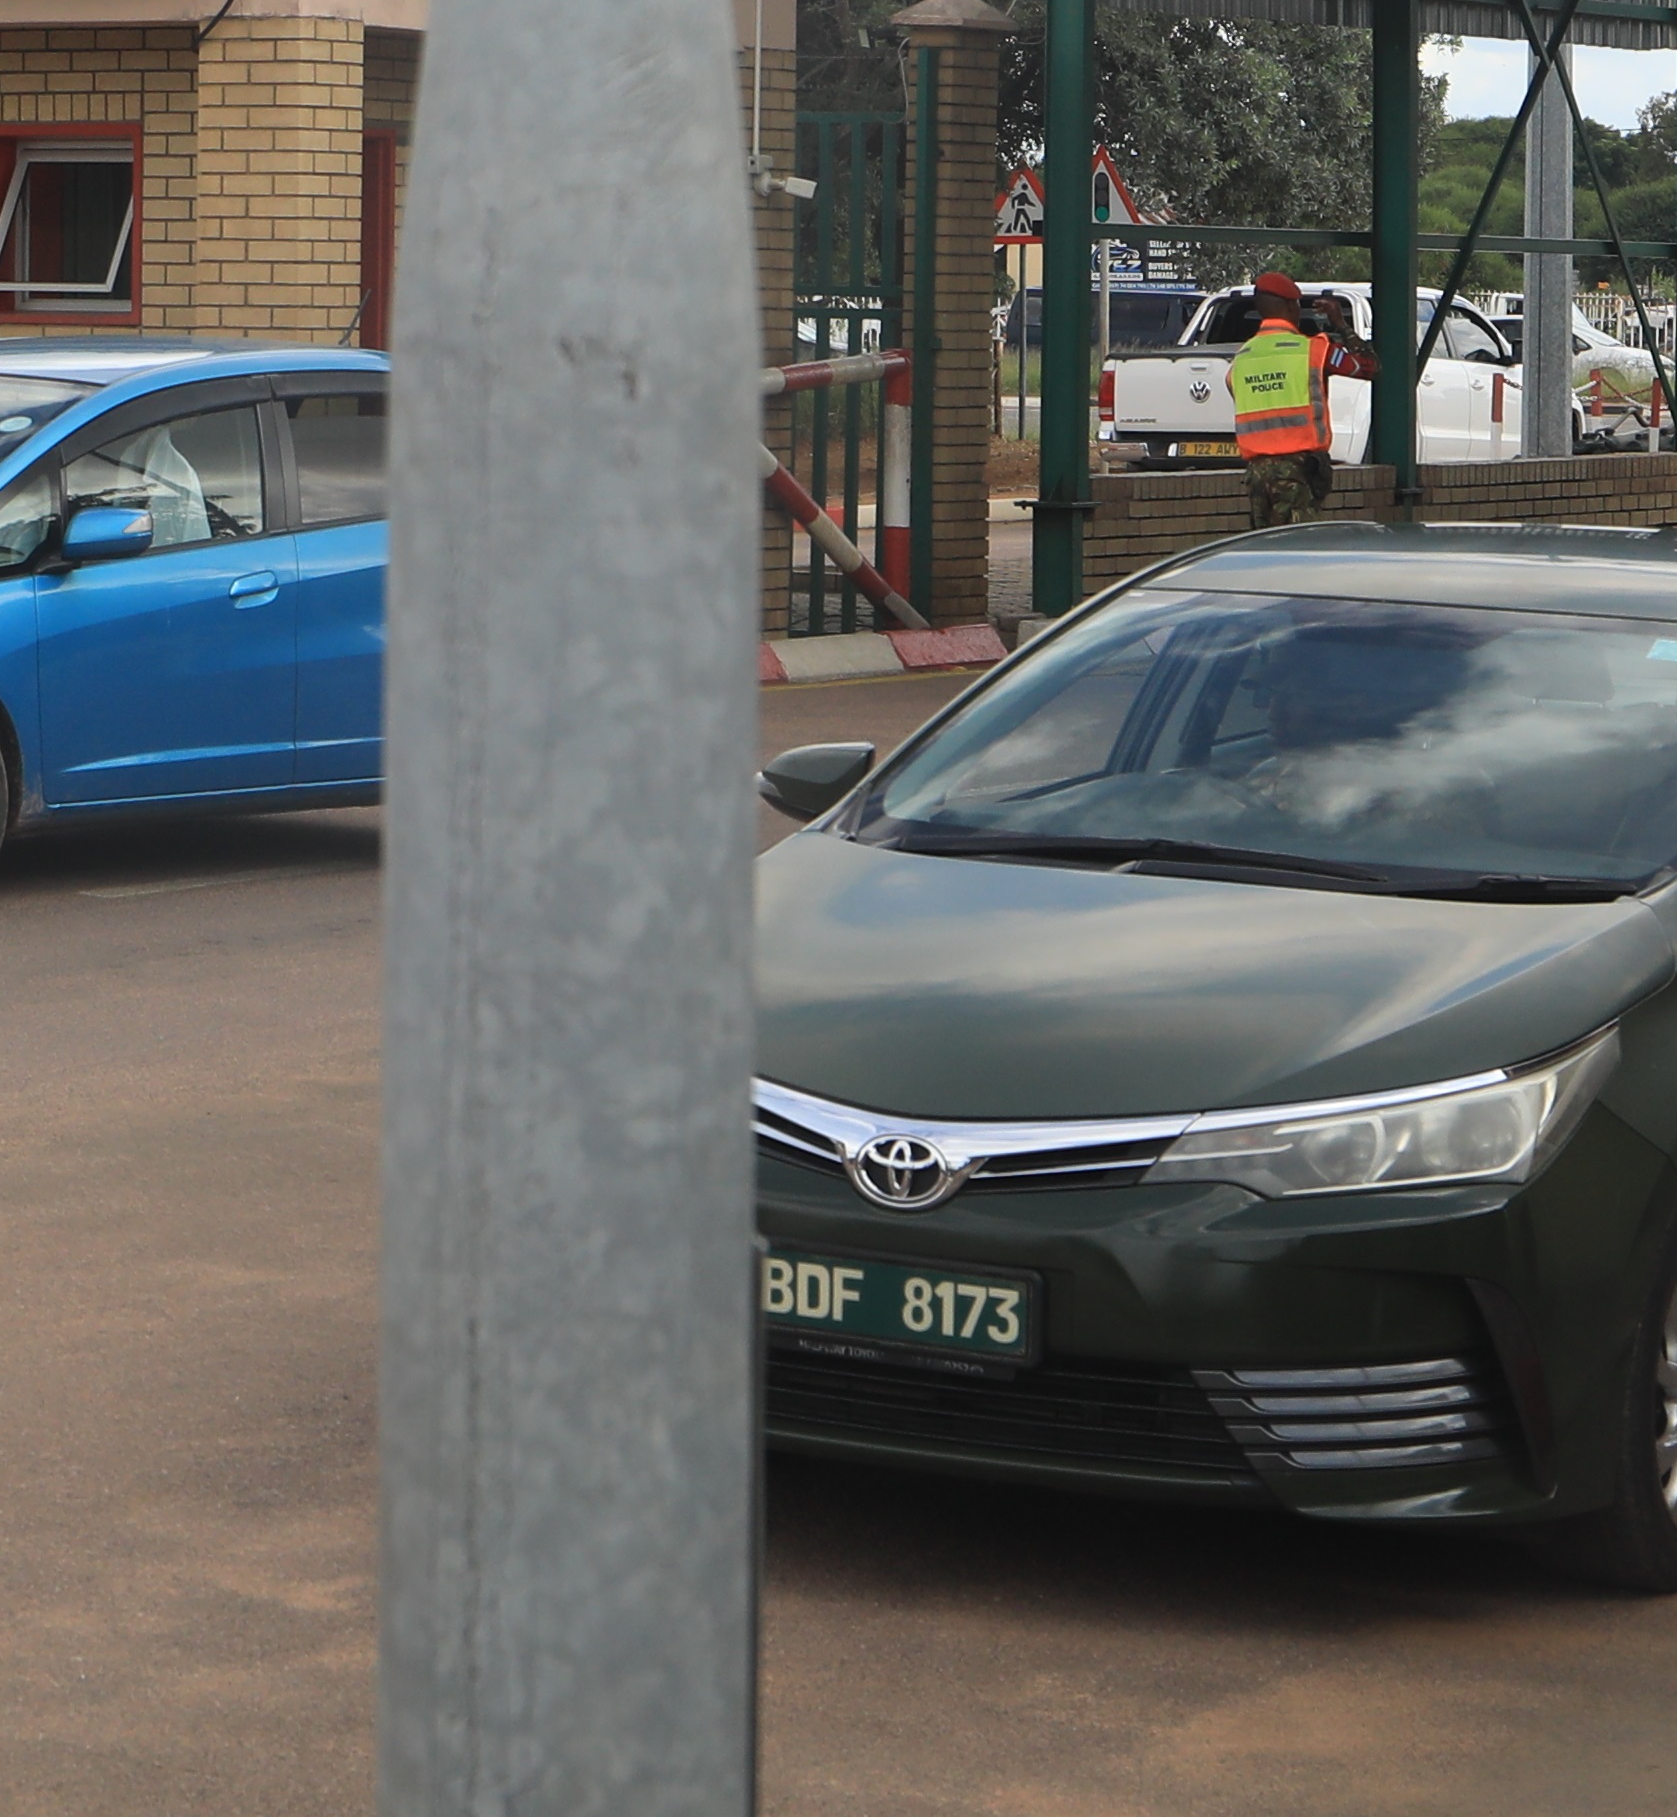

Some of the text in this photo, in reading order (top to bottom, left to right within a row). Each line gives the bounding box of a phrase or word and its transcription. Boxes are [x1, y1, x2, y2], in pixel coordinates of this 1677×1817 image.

[1244, 372, 1287, 384] MILITARY
[1251, 382, 1284, 393] POLICE
[1179, 443, 1186, 455] B
[1194, 442, 1212, 455] 122
[763, 1258, 1019, 1343] BDF 8173
